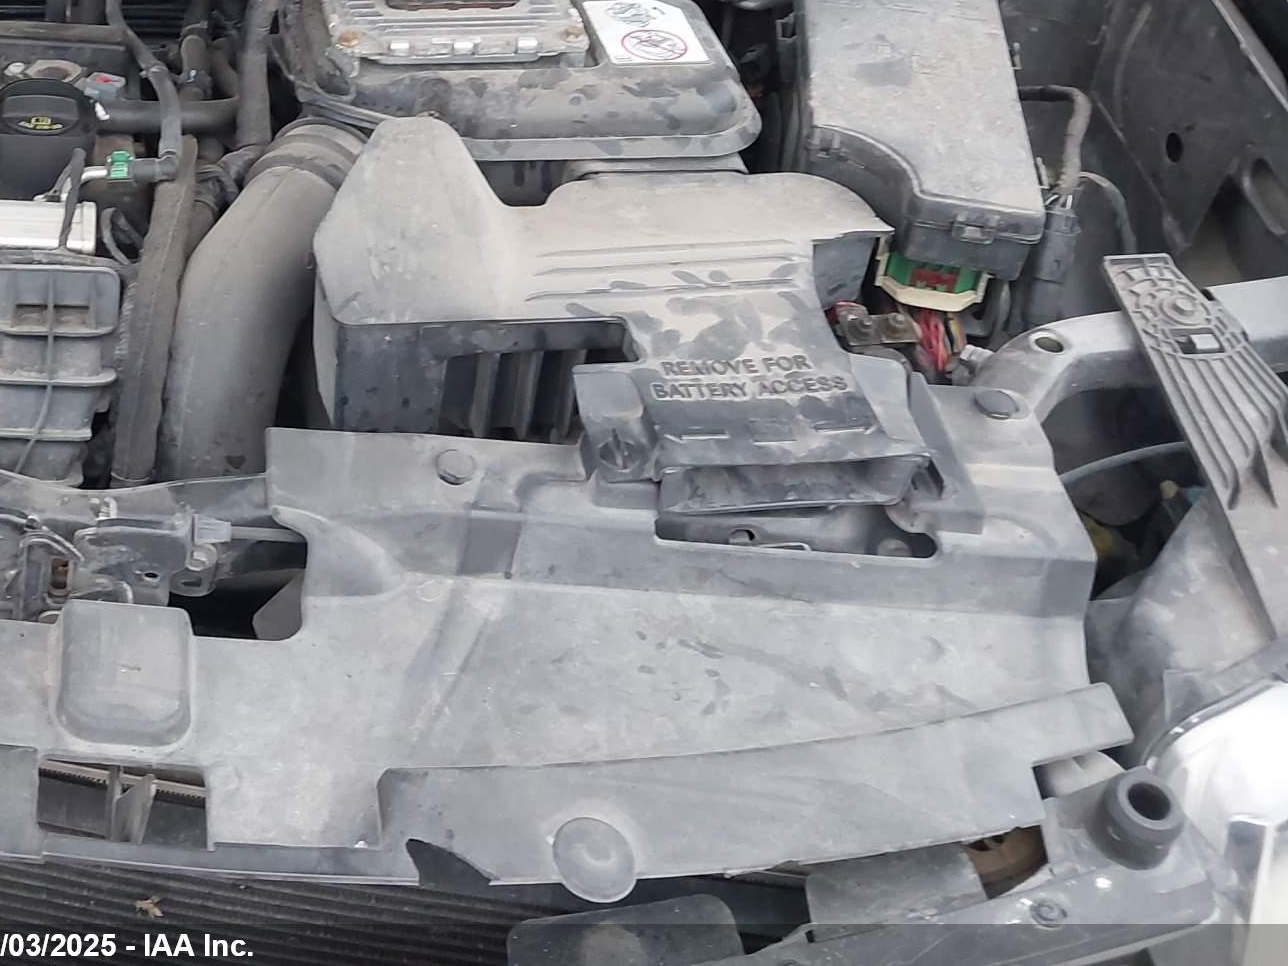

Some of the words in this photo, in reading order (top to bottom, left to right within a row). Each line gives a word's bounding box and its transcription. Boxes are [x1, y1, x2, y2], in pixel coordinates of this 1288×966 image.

[661, 358, 759, 376] REMOVE
[762, 354, 811, 373] FOR
[653, 383, 748, 399] BATTERY
[759, 376, 848, 396] ACCESS
